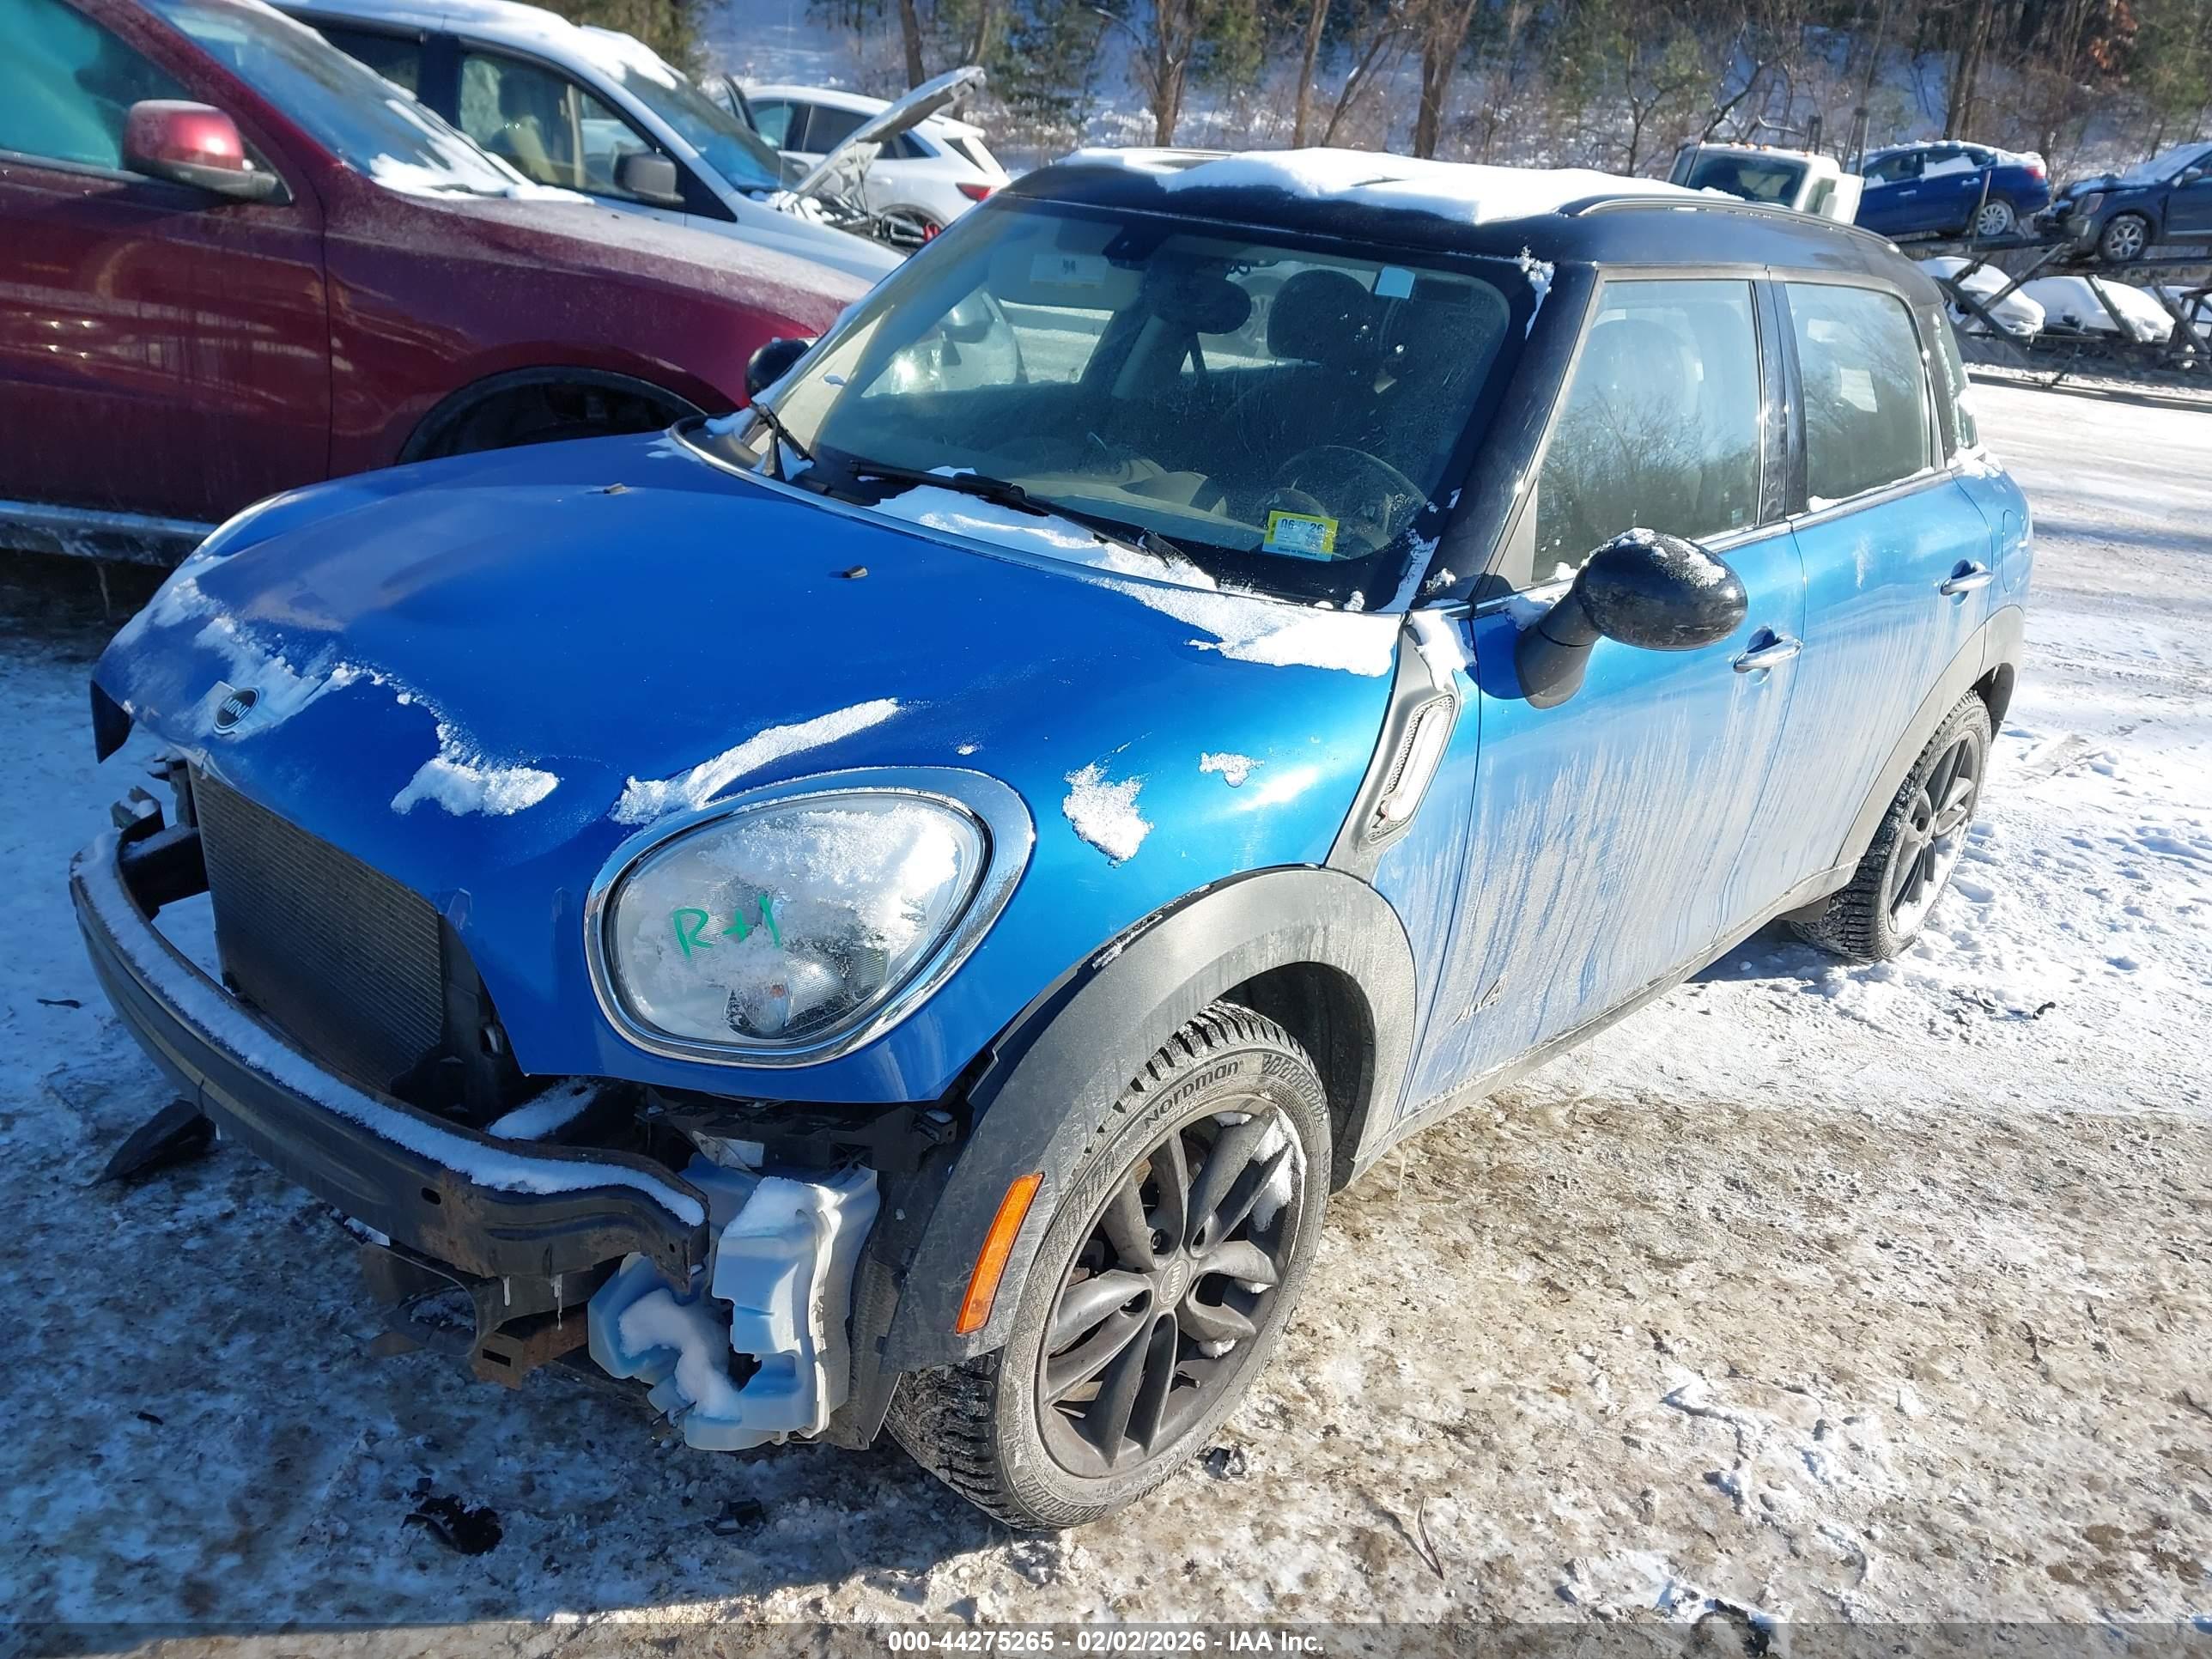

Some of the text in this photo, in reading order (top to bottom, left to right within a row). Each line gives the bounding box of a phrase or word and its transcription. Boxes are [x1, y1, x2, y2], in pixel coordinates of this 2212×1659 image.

[1281, 518, 1324, 533] 06 26
[222, 696, 250, 719] MINI
[1168, 1266, 1182, 1299] MINI
